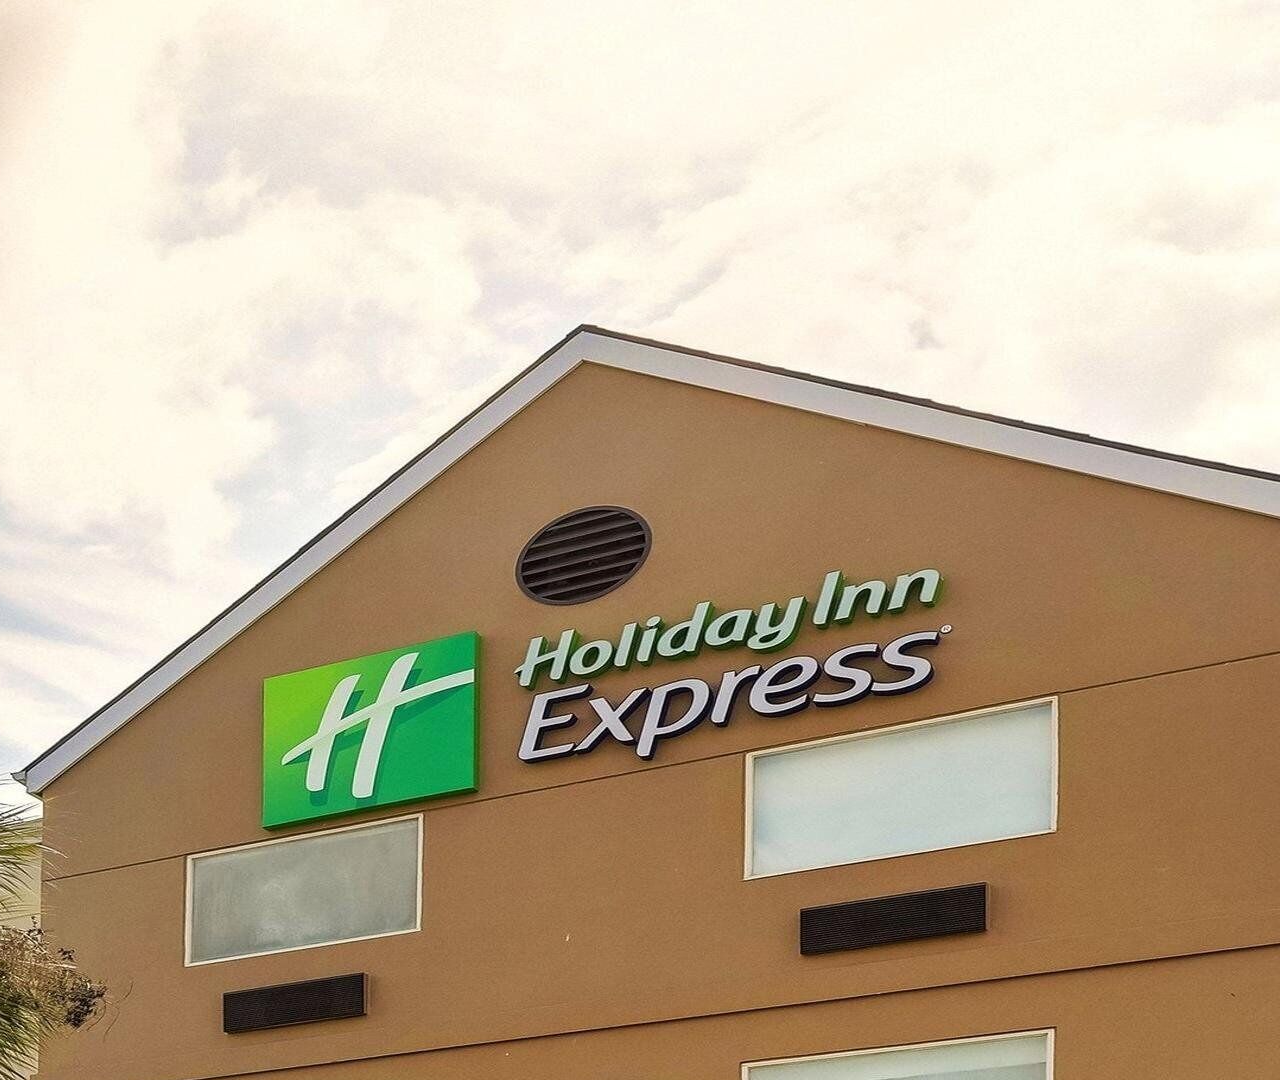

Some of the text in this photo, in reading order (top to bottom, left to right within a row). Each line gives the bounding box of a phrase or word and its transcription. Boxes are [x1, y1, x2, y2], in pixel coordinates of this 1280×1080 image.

[514, 569, 941, 688] Holiday Inn
[518, 631, 940, 761] Express
